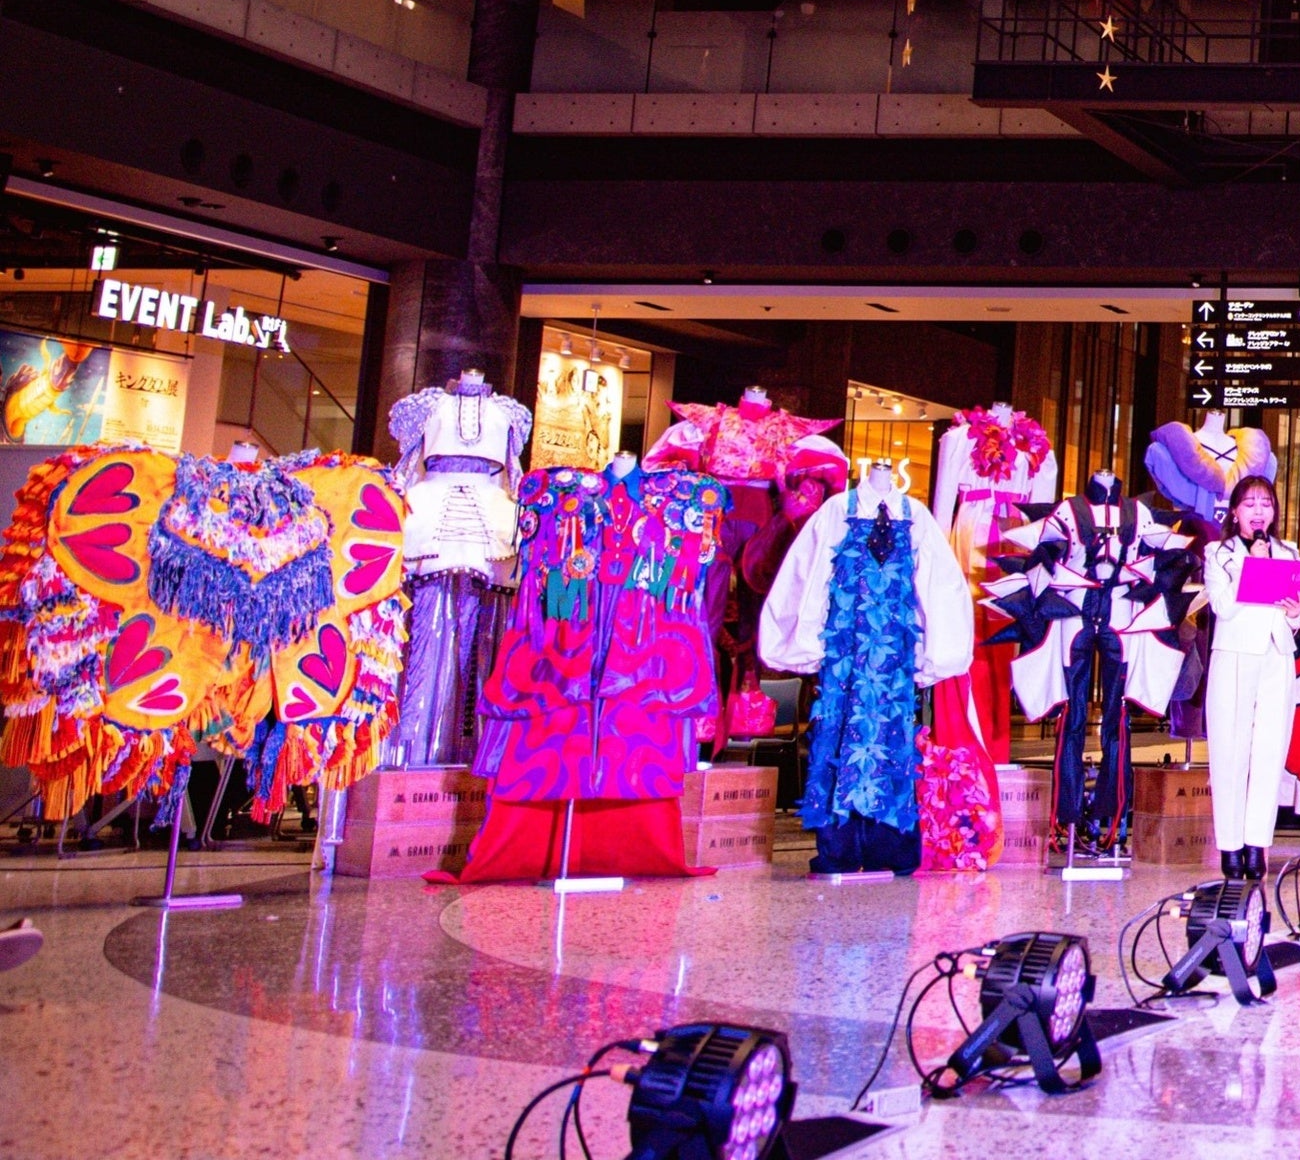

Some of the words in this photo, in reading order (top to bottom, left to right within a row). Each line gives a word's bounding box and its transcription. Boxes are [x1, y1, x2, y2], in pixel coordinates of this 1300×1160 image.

[98, 278, 198, 333] EVENT
[202, 301, 255, 345] Lab.
[412, 792, 438, 803] GRAND
